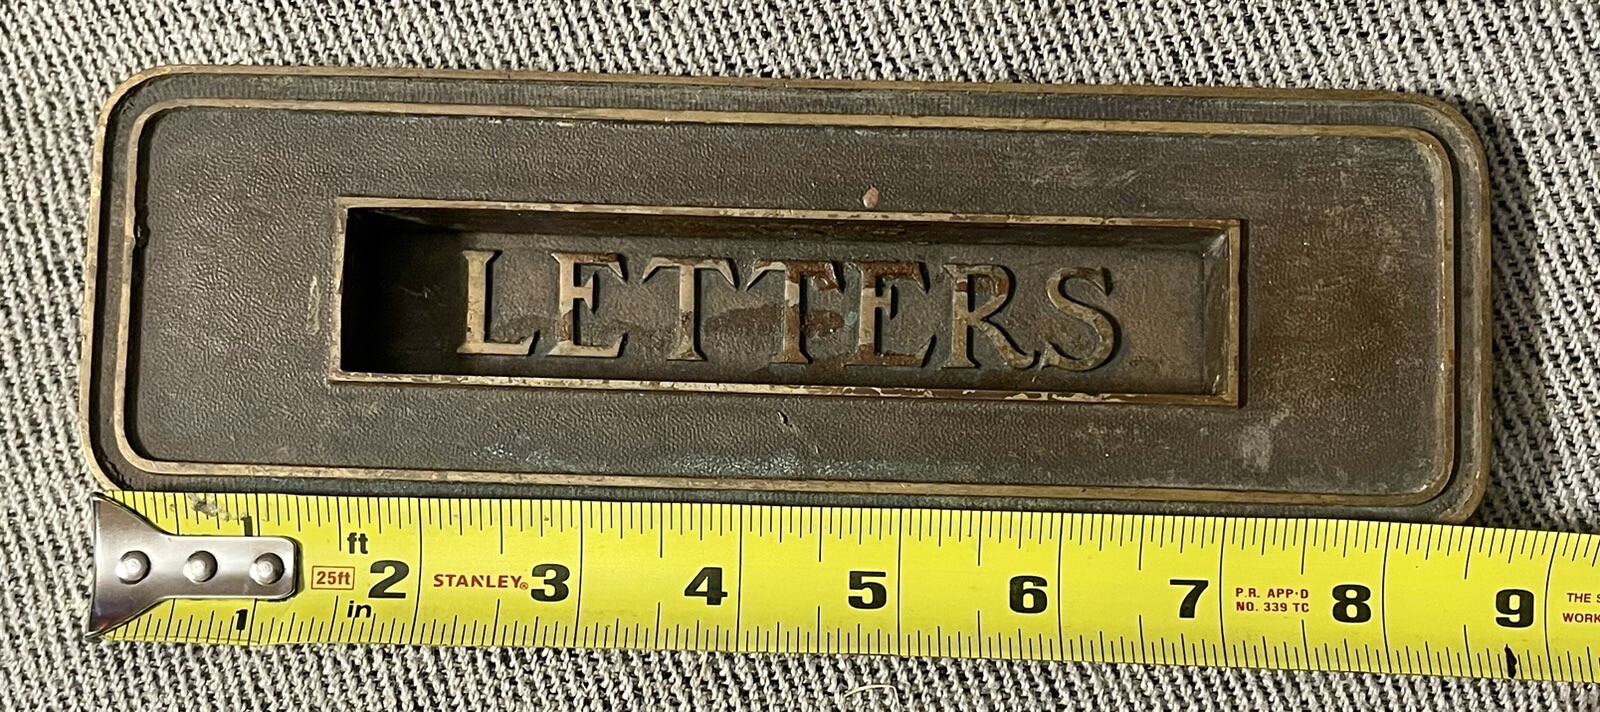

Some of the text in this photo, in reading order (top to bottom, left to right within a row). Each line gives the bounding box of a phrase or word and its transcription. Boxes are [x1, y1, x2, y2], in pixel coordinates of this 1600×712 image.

[457, 249, 1123, 371] LETTERS
[240, 516, 253, 536] 1
[347, 532, 368, 554] ft
[316, 570, 351, 586] 25ft
[368, 560, 410, 599] 2
[531, 563, 571, 602] 3
[684, 566, 728, 606] 4
[848, 570, 887, 609] 5
[1009, 575, 1048, 613] 6
[1235, 587, 1260, 598] P.R.
[347, 600, 372, 618] in
[1169, 579, 1209, 618] 7
[1236, 601, 1310, 613] NO. 339 TC
[1331, 584, 1372, 624] 8
[1495, 589, 1535, 628] 9
[1566, 592, 1592, 603] THE
[235, 609, 248, 630] 1
